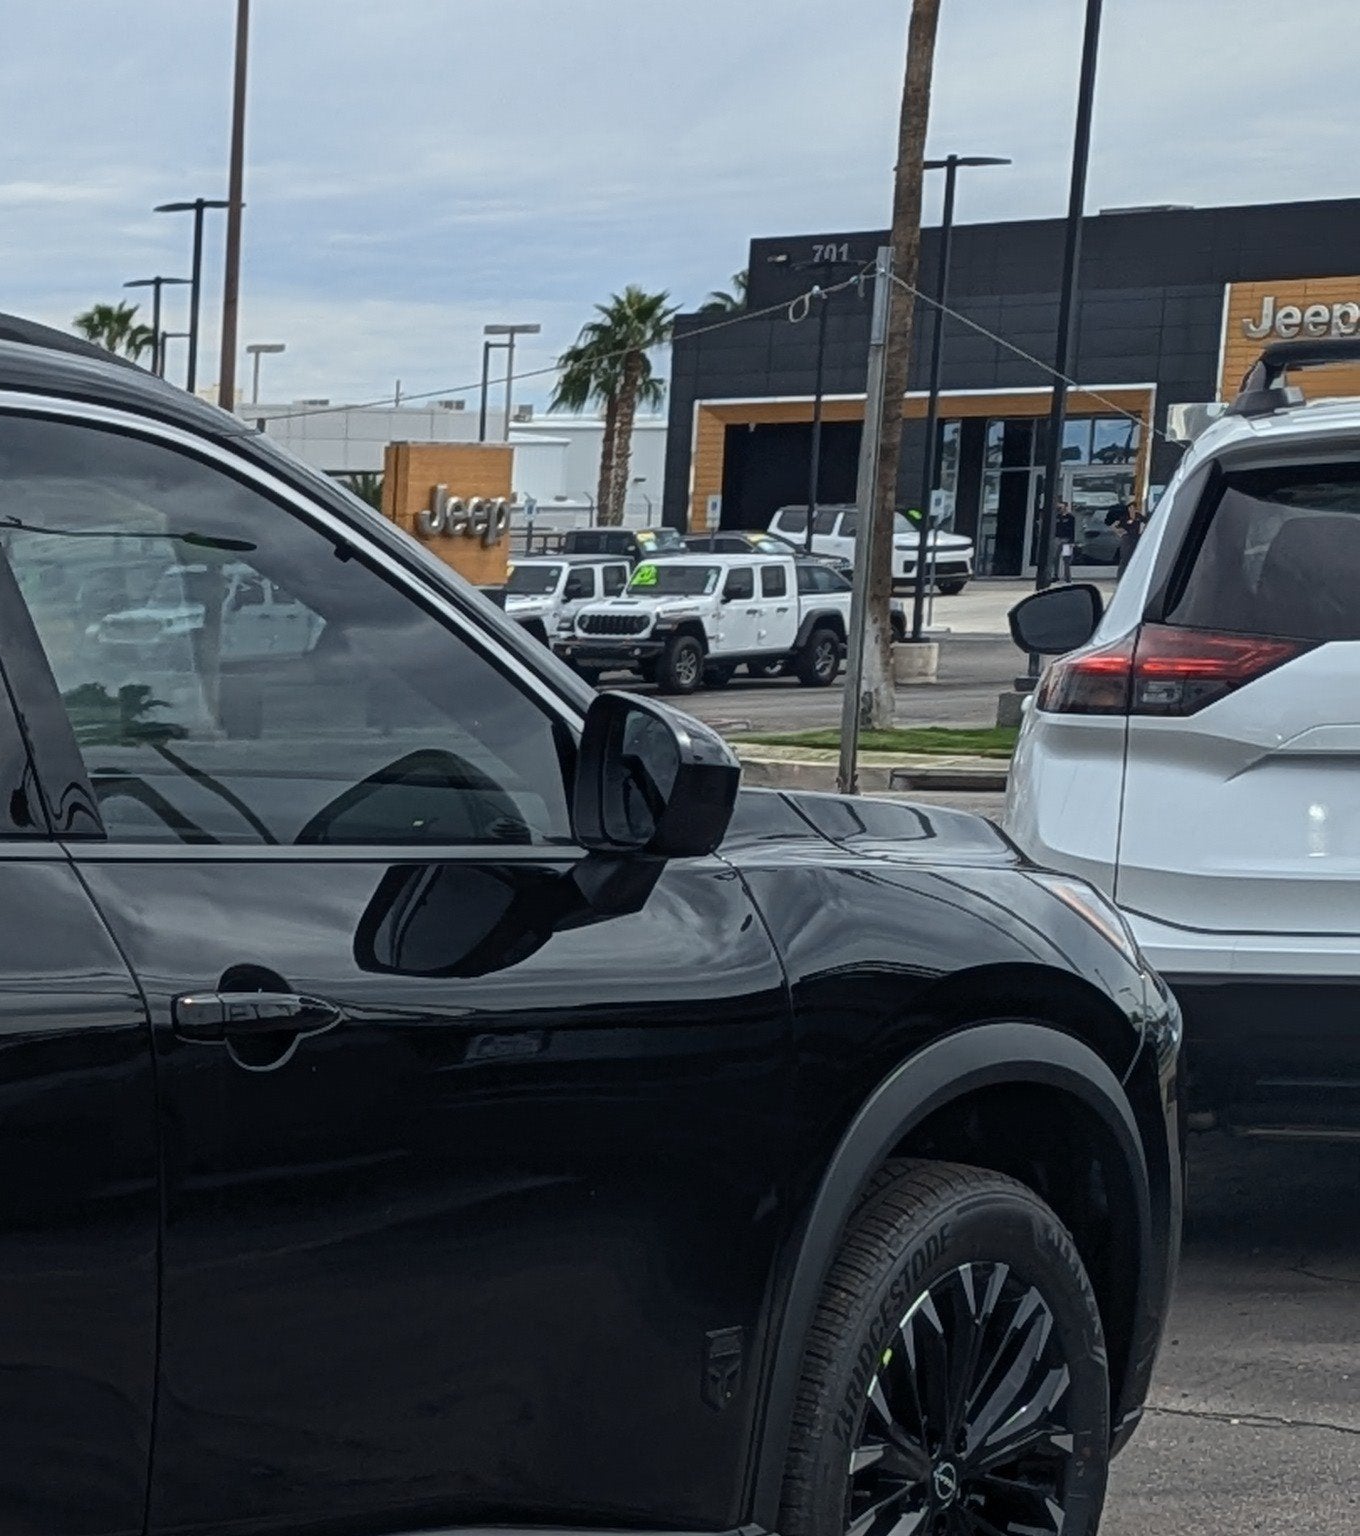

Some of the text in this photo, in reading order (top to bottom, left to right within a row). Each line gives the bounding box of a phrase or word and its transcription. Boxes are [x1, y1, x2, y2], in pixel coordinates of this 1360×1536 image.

[812, 242, 849, 263] 701
[1242, 295, 1360, 339] Jeep
[419, 483, 510, 546] Jeep
